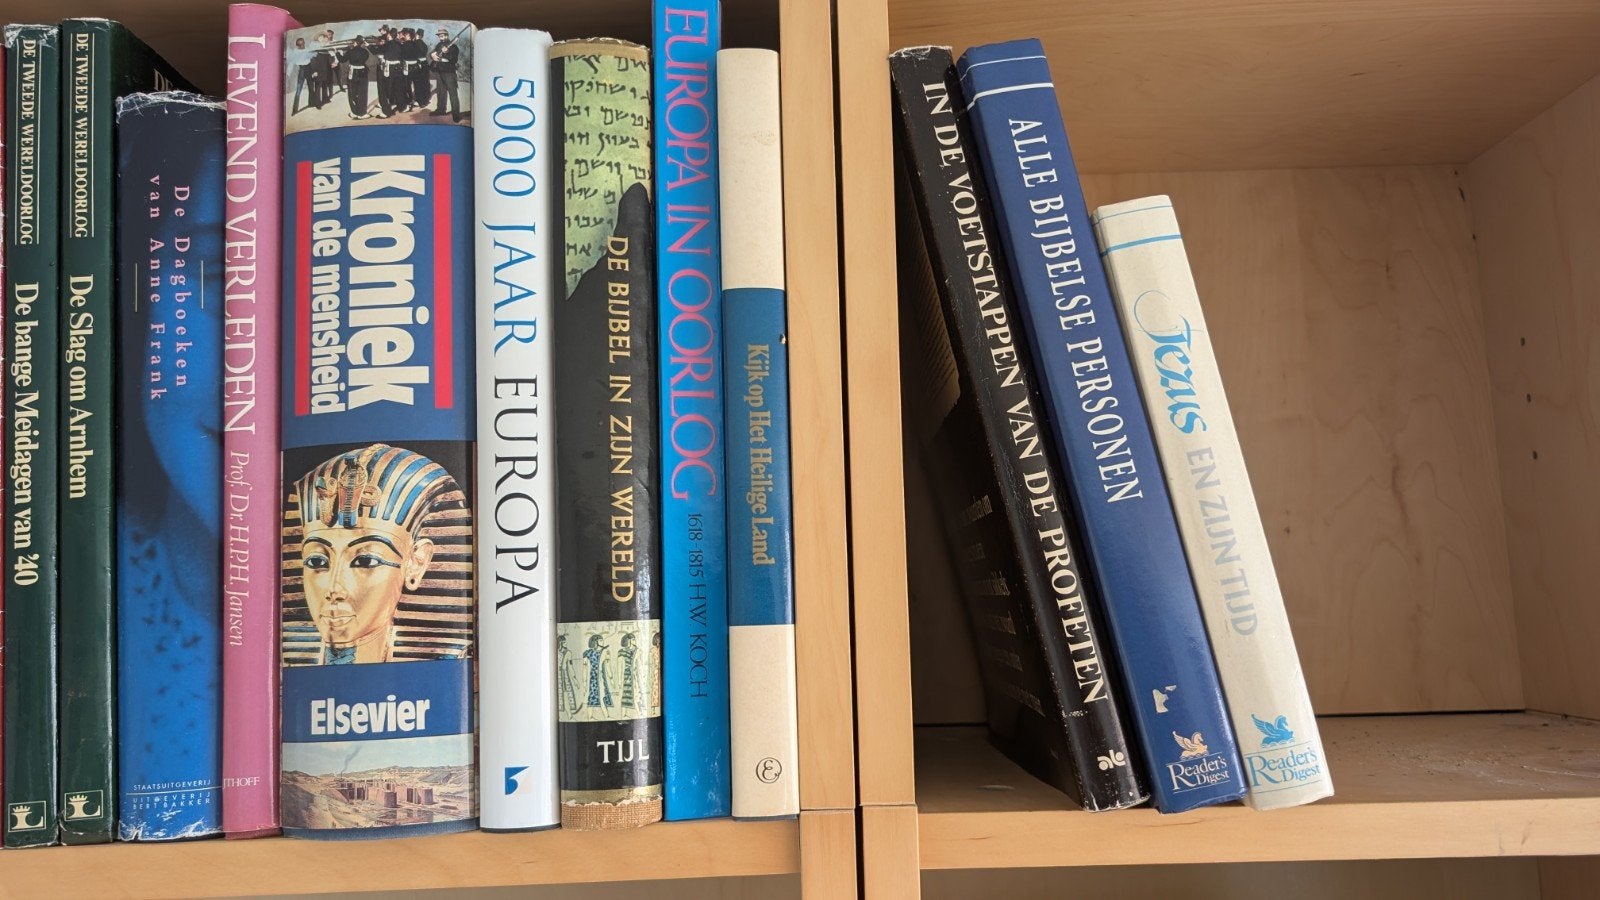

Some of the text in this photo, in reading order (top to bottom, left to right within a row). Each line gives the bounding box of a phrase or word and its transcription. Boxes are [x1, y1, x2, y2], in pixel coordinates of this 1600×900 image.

[20, 39, 36, 245] DE TWEEDE WERELDOORLOG
[75, 33, 88, 238] DE TWEEDE WERELDOORLOG
[15, 282, 39, 315] De
[150, 175, 167, 400] van Anne Frank
[170, 186, 193, 387] De Dagboeken
[224, 33, 266, 435] LEVEND VERLEDEN
[311, 157, 346, 414] van de mensheid
[347, 155, 430, 410] Kroniek
[664, 7, 717, 500] EUROPA IN OORLOG
[11, 320, 39, 387] bange
[481, 76, 539, 614] 5000 JAAR EUROPA
[1008, 118, 1144, 503] ALLE BIJBELSE PERSONEN
[1134, 290, 1207, 434] Jezus
[10, 390, 39, 504] Meidagen
[66, 274, 94, 499] De Slag om Arnhem
[608, 236, 634, 602] DE BIJBEL IN ZIJN WERELD
[744, 344, 775, 566] Kijk op Het Heilige Land
[922, 80, 1108, 704] IN DE VOETSTAPPEN VAN DE PROFETEN
[14, 507, 32, 549] van
[225, 451, 252, 488] Prof.
[1186, 447, 1258, 636] EN ZIJN TIJD
[225, 585, 249, 646] Jansen
[689, 583, 707, 626] H.W.
[690, 633, 708, 698] KOCH
[133, 779, 211, 791] STAATSUITGEVERIJ
[311, 695, 430, 735] Elsevier
[597, 739, 650, 764] TIJL
[1167, 755, 1227, 790] Reader's
[1195, 770, 1230, 784] Digest
[1246, 747, 1317, 786] Reader's
[1281, 765, 1320, 783] Digest
